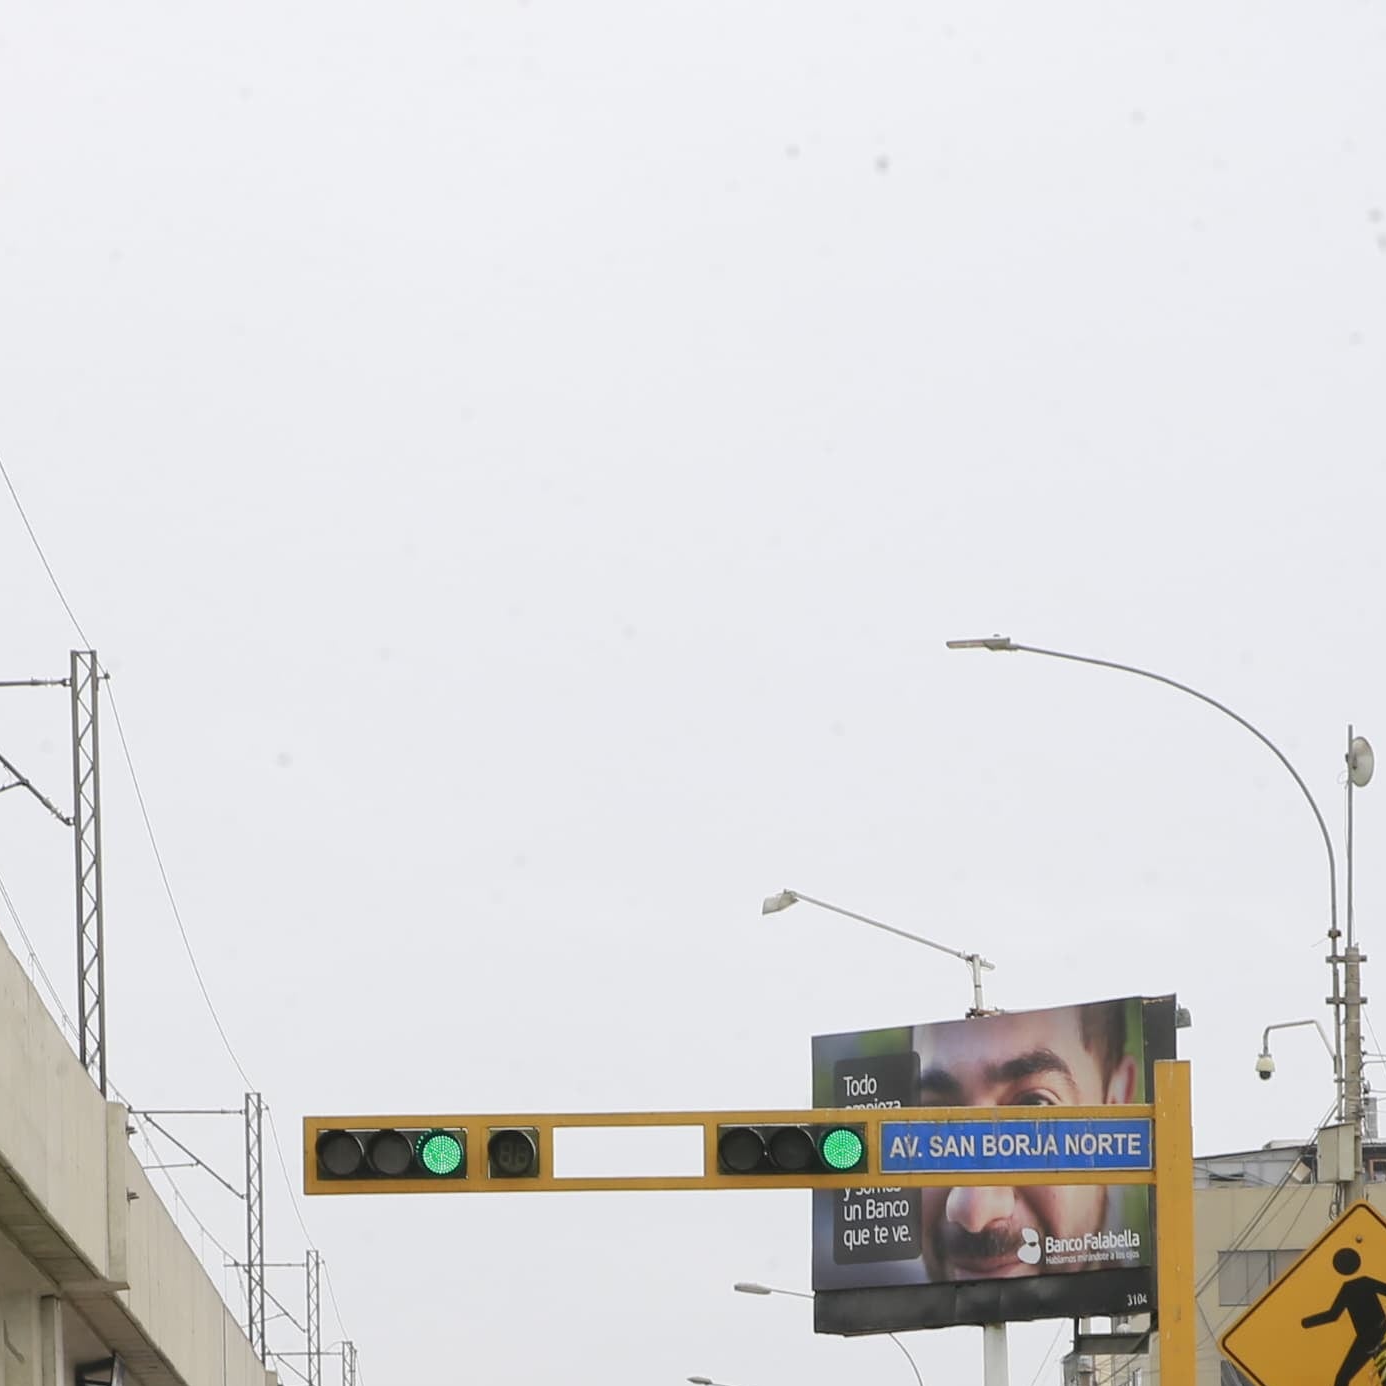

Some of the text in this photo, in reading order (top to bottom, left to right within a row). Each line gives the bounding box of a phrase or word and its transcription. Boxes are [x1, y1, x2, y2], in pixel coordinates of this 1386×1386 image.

[843, 1074, 877, 1097] Todo
[890, 1133, 1142, 1158] AV. SAN BORJA NORTE
[844, 1199, 909, 1221] un Banco
[844, 1225, 912, 1251] que te ve.
[1045, 1229, 1141, 1253] Banco Falabella
